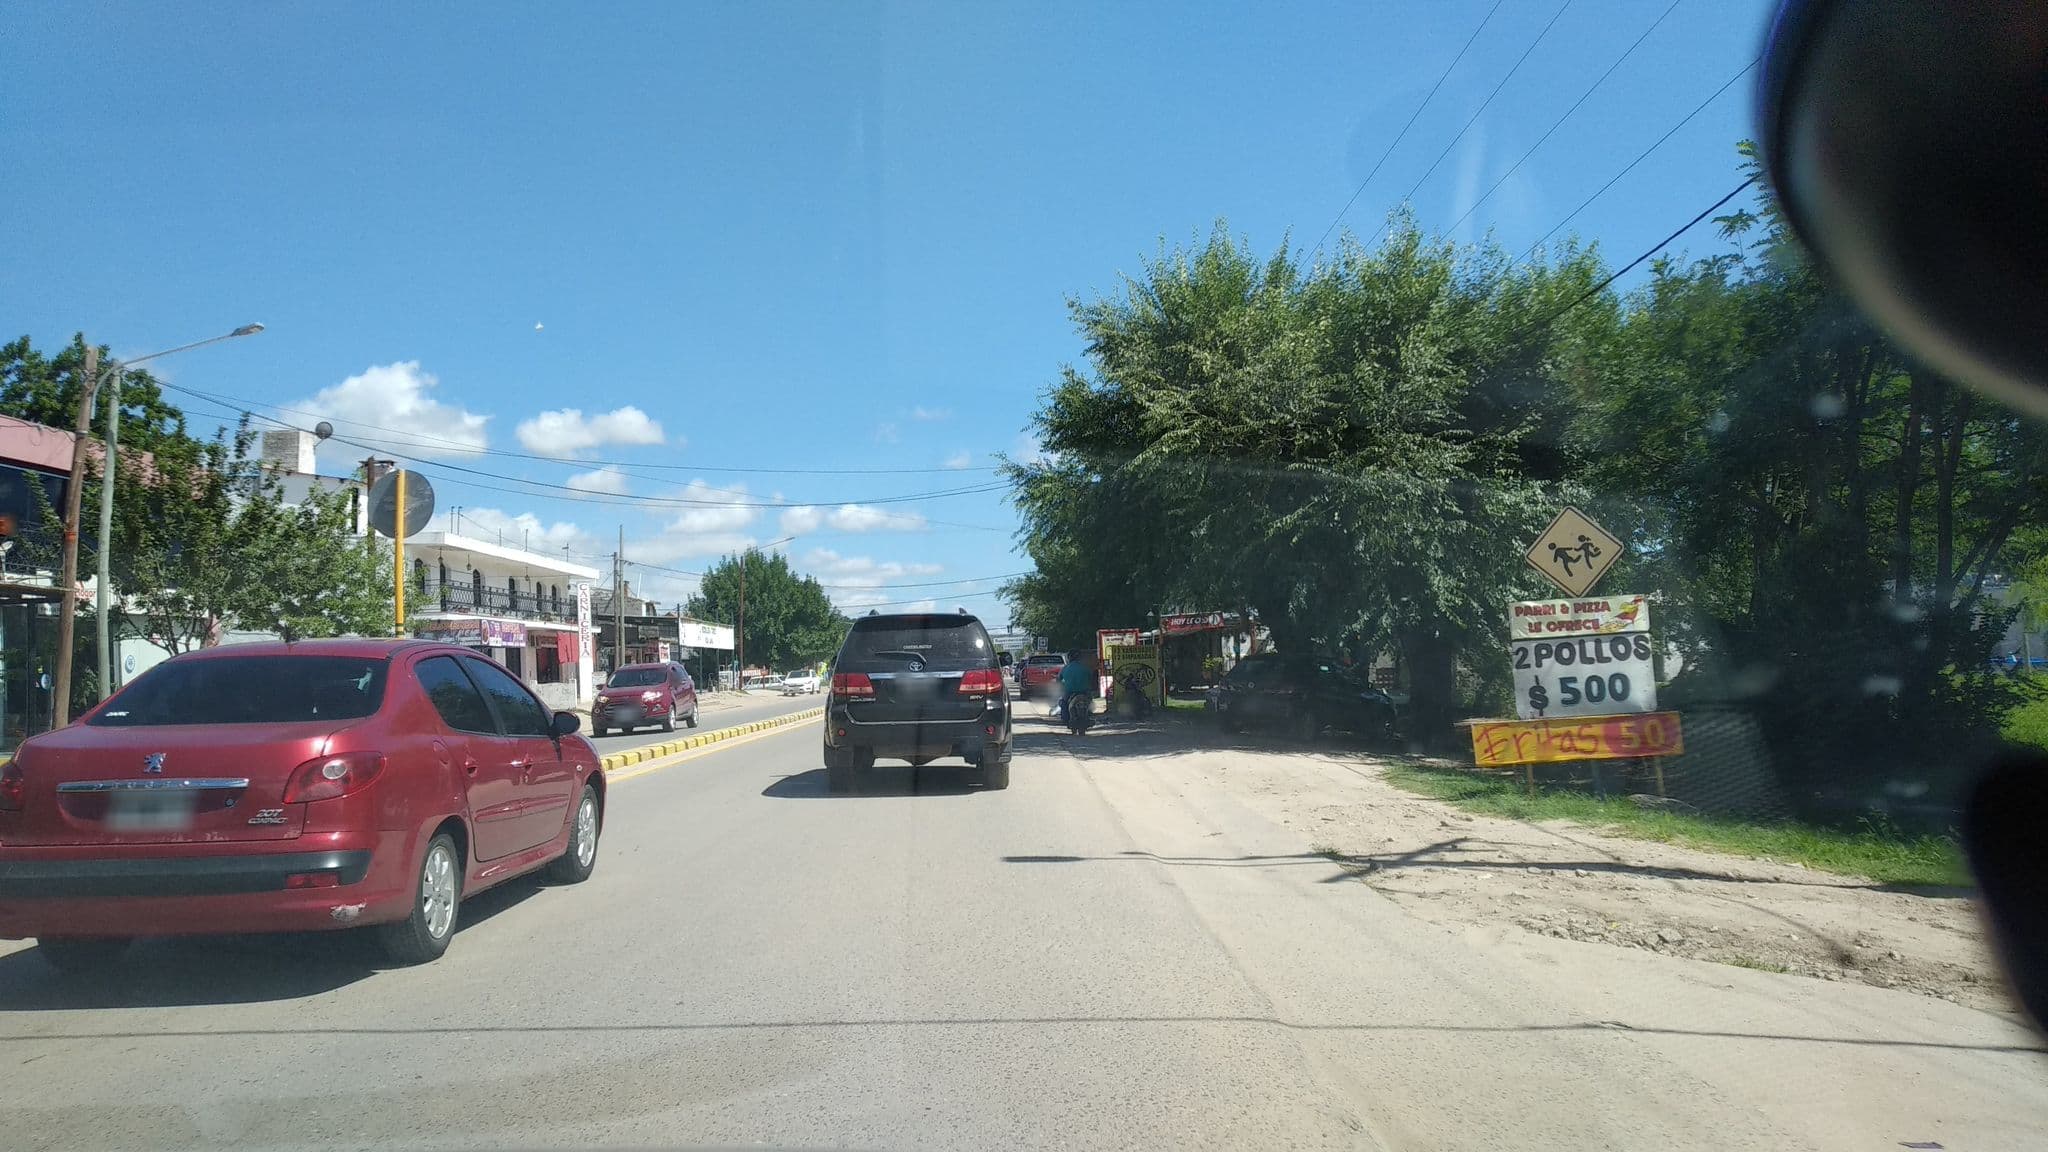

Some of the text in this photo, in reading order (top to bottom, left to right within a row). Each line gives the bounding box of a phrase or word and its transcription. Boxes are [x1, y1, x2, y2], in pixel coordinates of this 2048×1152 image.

[579, 584, 591, 657] CARNICERIA
[1514, 601, 1612, 617] PARRI & PIZZA
[1527, 618, 1600, 633] LE OFRECE
[1514, 634, 1652, 670] 2 POLLOS
[1529, 672, 1632, 716] $ 500
[1620, 719, 1667, 750] 50
